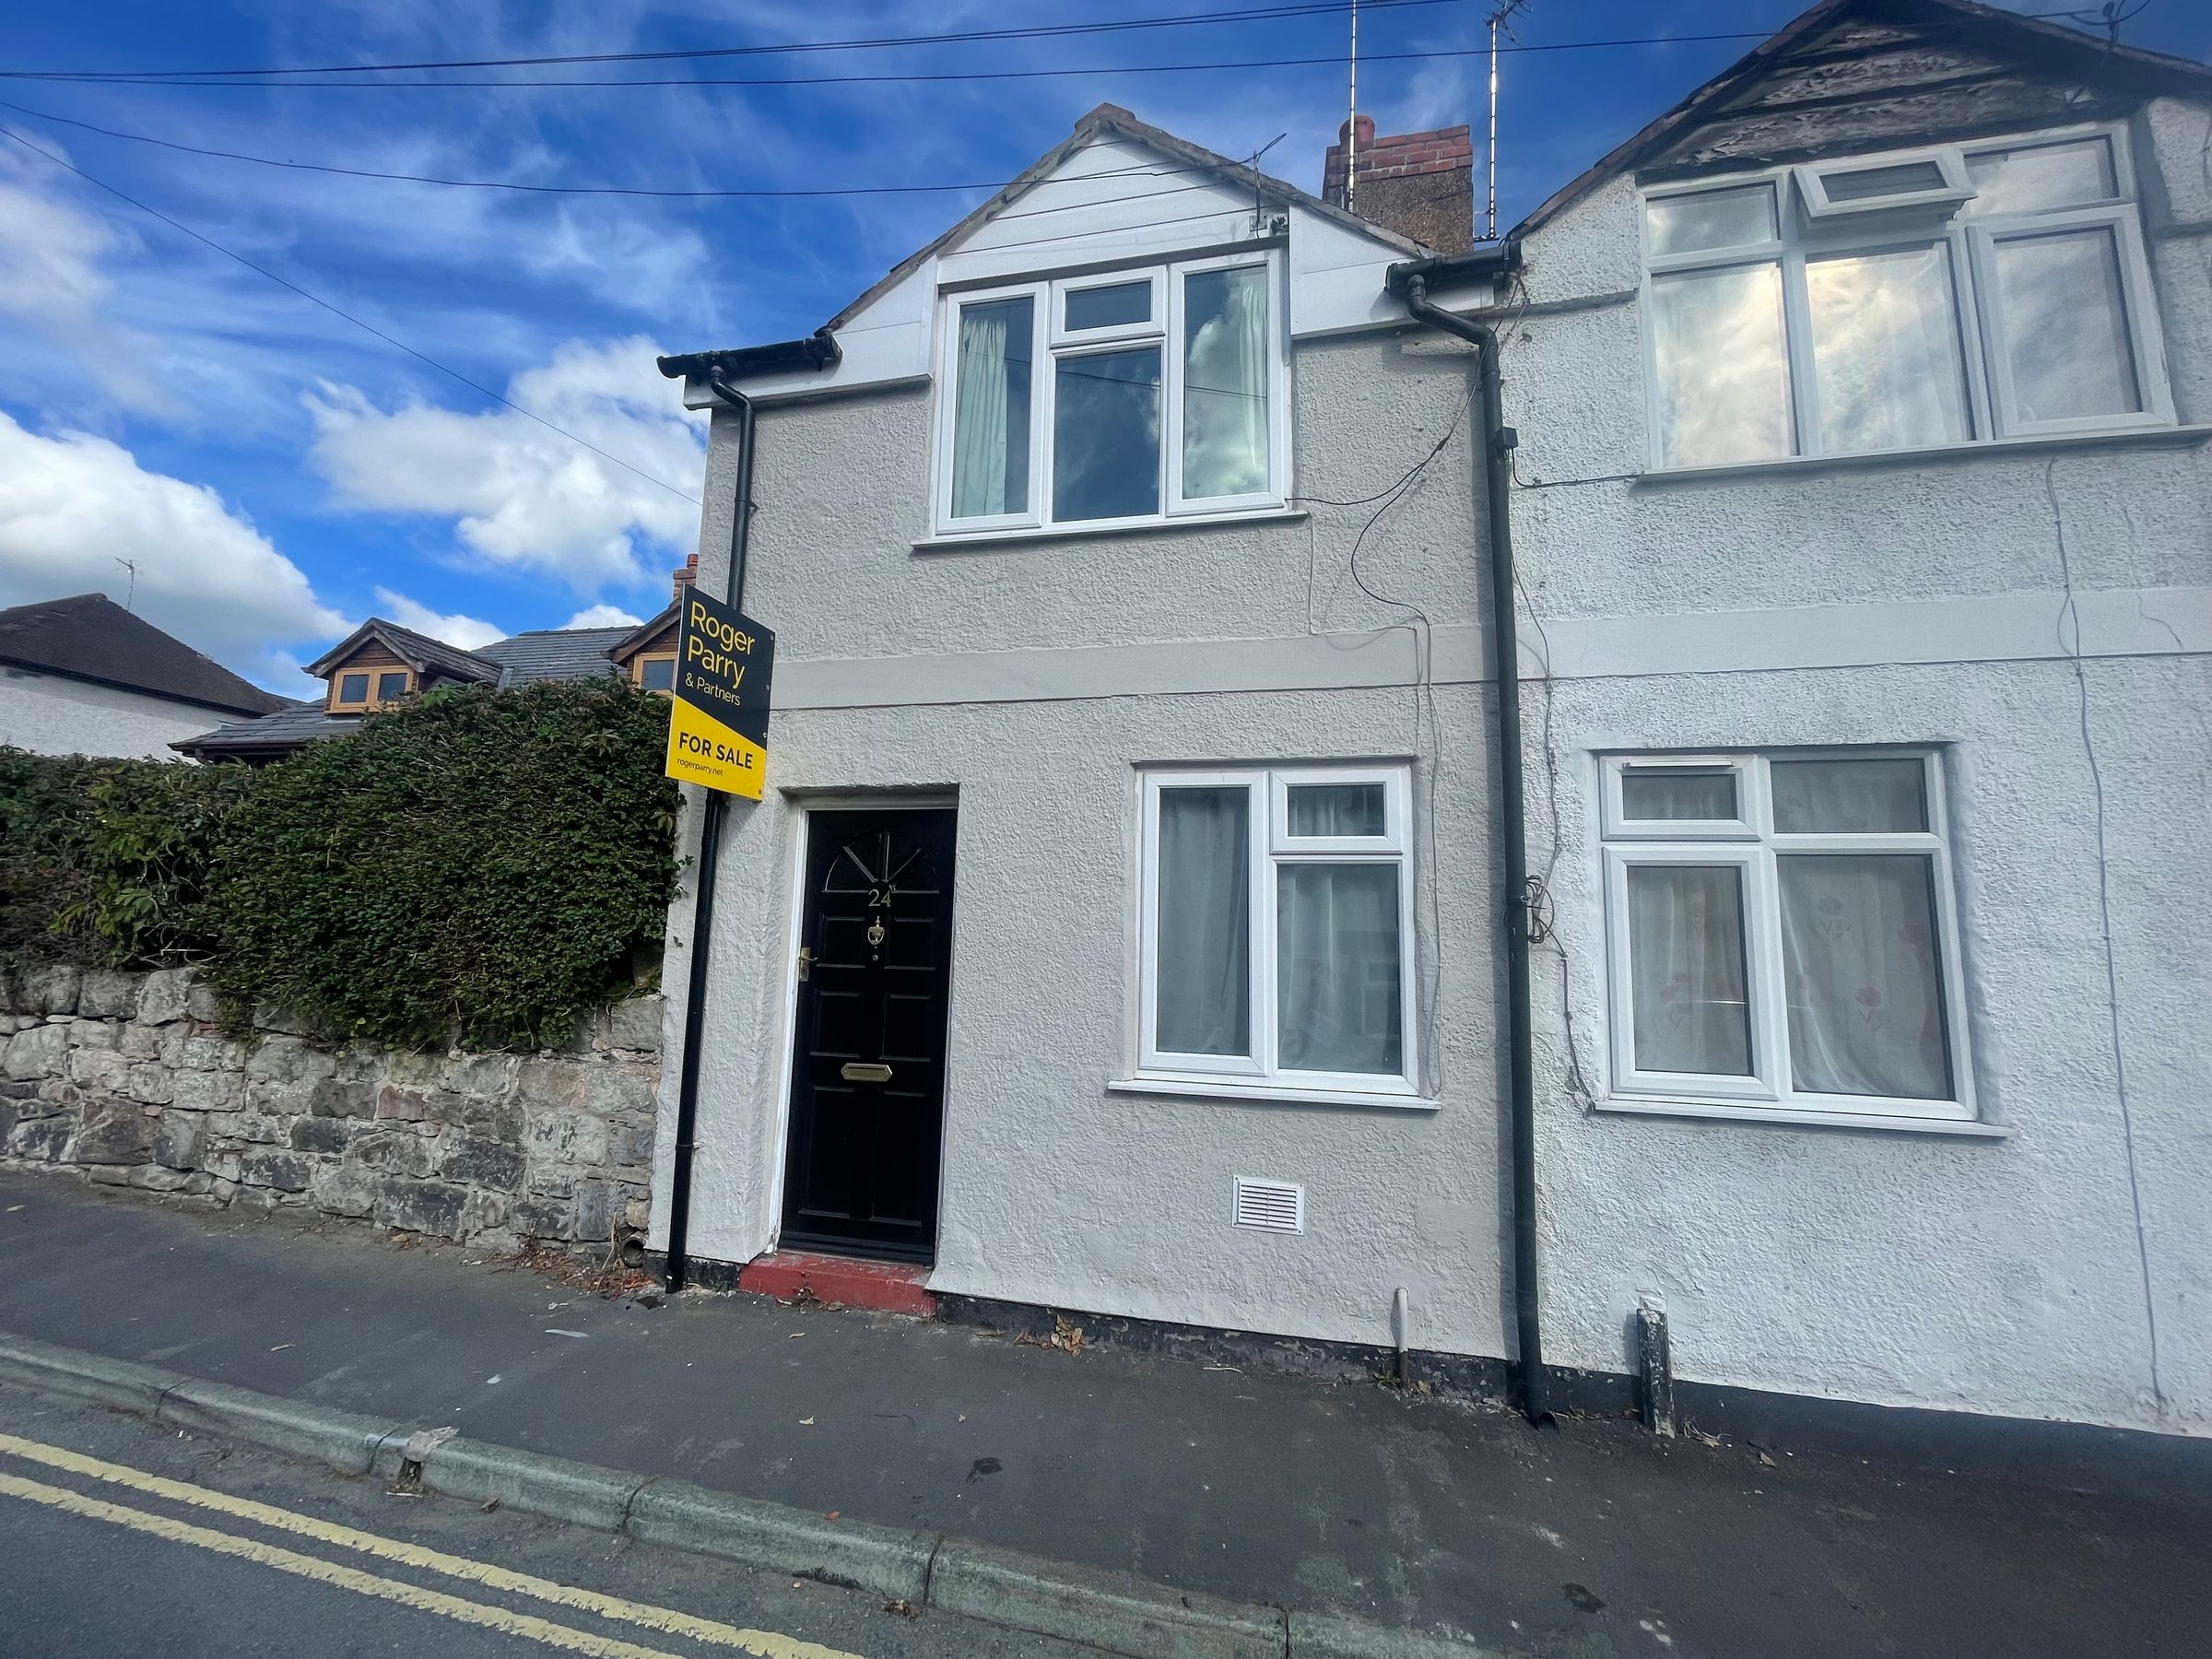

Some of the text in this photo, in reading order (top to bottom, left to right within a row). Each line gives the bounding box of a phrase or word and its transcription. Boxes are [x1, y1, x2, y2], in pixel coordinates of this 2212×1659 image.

[690, 600, 755, 655] Roger
[688, 634, 746, 689] Parry
[685, 672, 741, 706] & Partners
[677, 758, 724, 776] rogerparry.net
[678, 731, 753, 770] FOR SALE
[868, 888, 891, 908] 24
